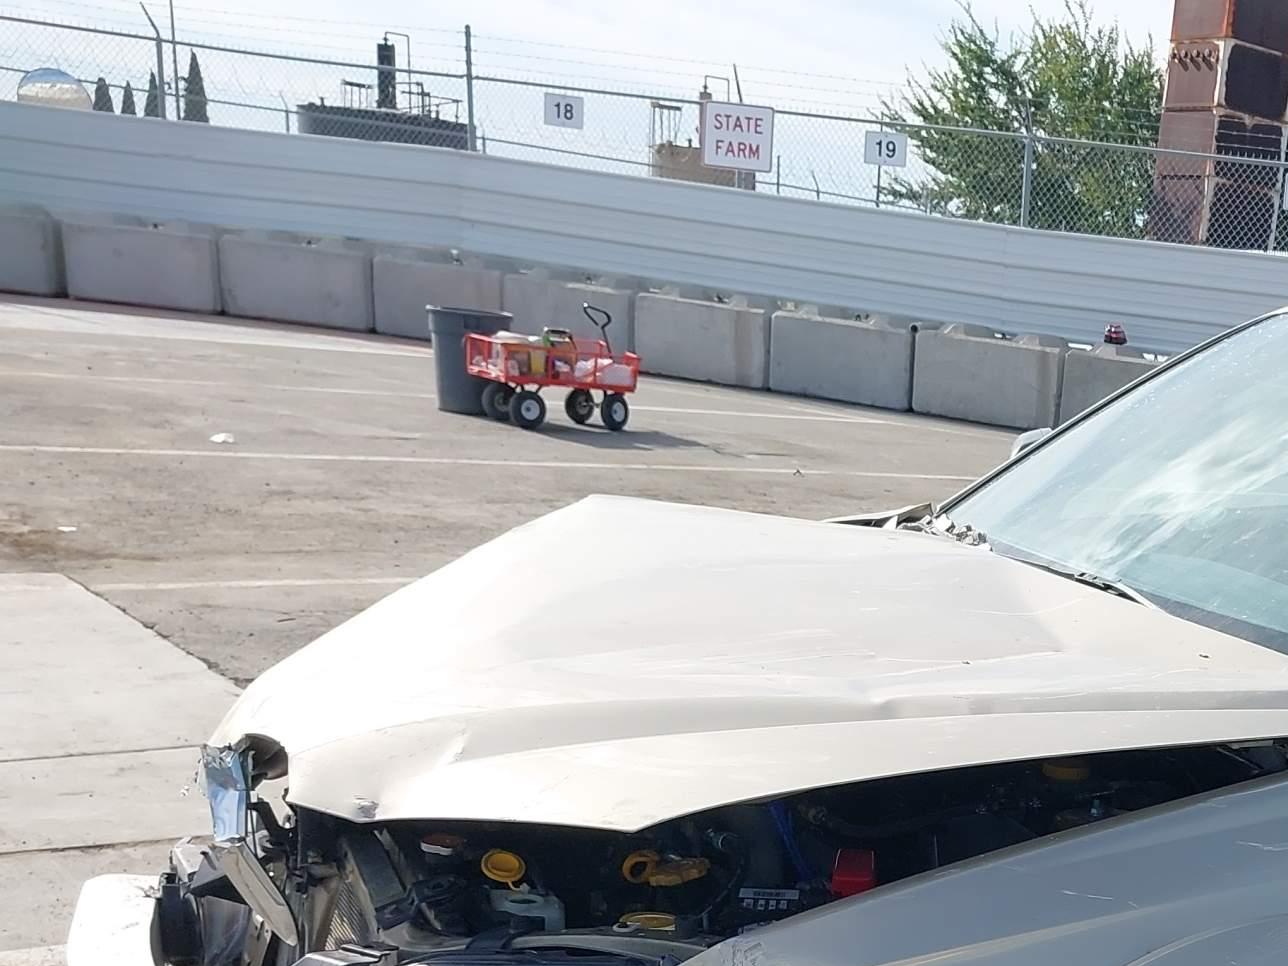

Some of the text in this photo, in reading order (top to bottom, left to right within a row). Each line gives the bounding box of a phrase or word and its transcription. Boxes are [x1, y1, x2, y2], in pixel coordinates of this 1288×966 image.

[554, 102, 574, 120] 18
[714, 114, 763, 134] STATE
[716, 140, 760, 160] FARM
[876, 140, 896, 158] 19
